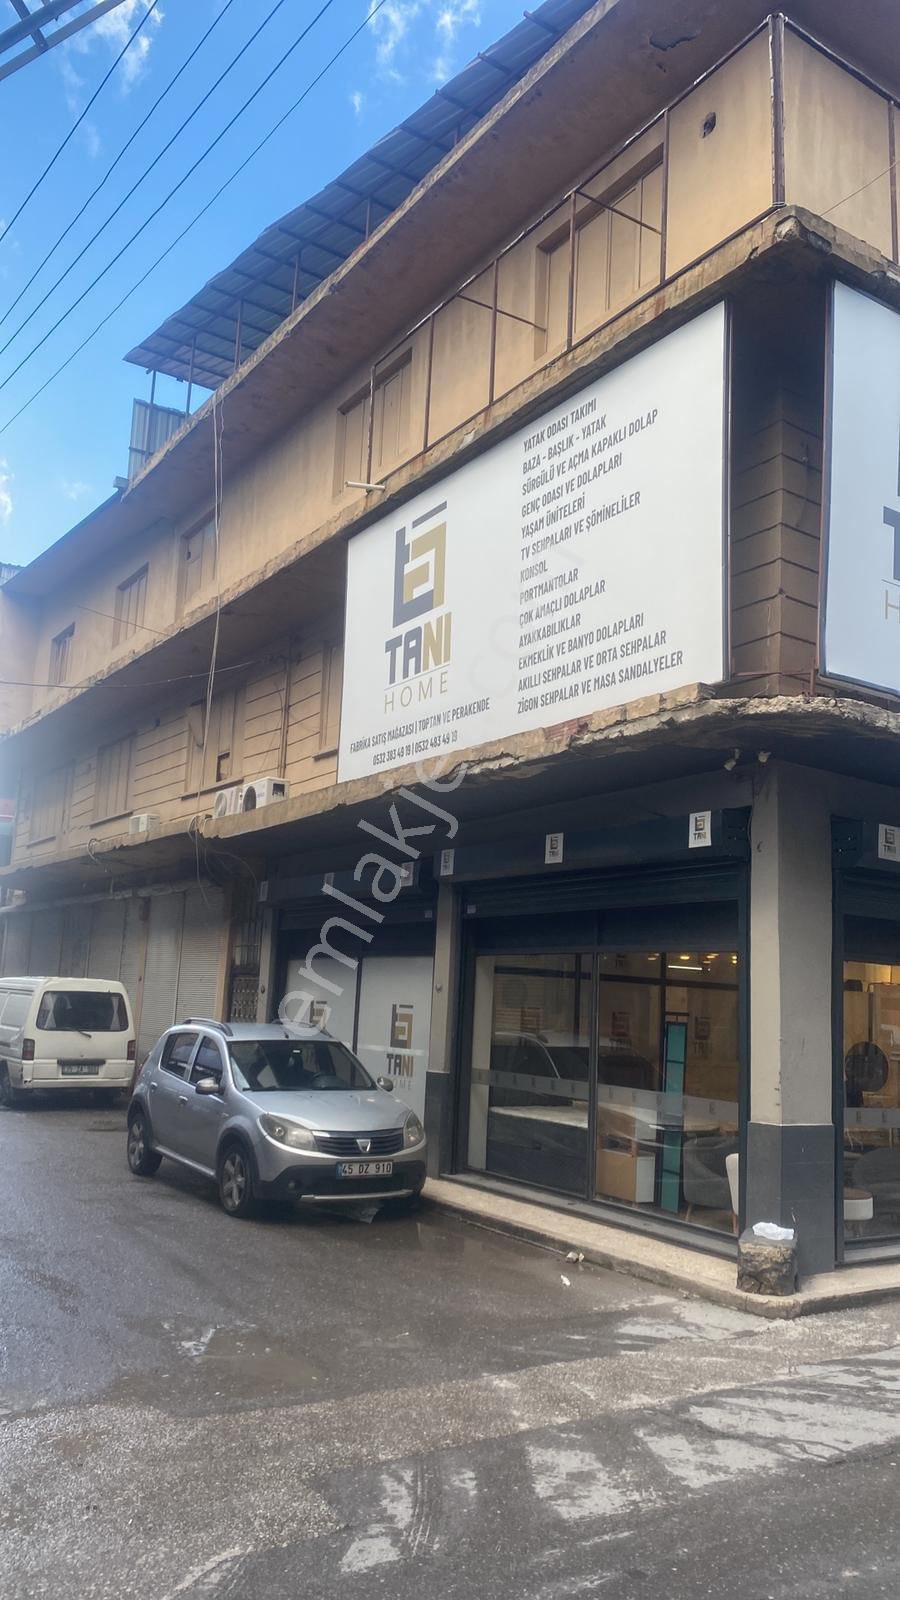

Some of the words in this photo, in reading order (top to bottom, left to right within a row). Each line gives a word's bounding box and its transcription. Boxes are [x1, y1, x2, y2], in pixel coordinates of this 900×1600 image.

[522, 454, 541, 475] BAZA
[548, 434, 574, 460] BAŞLIK
[581, 414, 606, 440] YATAK
[522, 464, 554, 496] SÜRGÜLÜ
[557, 460, 567, 477] VE
[568, 448, 589, 471] AÇMA
[592, 426, 626, 458] KAPAKLI
[629, 408, 658, 437] DOLAP
[524, 429, 545, 453] YATAK
[547, 416, 568, 439] ODASI
[570, 398, 597, 424] TAKIMI
[522, 497, 540, 518] GENÇ
[542, 484, 563, 507] ODASI
[565, 478, 575, 494] VE
[577, 452, 622, 489] DOLAPLARI
[521, 545, 531, 560] TV
[532, 525, 572, 556] SEHPALARI
[574, 519, 585, 535] VE
[586, 491, 640, 533] ŞÖMİNELİLER
[522, 516, 544, 539] YAŞAM
[546, 491, 585, 527] ÜNİTELERİ
[520, 560, 548, 583] KONSOL
[520, 567, 579, 605] PORTMANTOLAR
[519, 609, 534, 629] ÇOK
[564, 579, 606, 608] DOLAPLAR
[519, 612, 581, 648] AYAKKABILIKLAR
[385, 611, 452, 686] TANI
[518, 642, 554, 670] EKMEKLİK
[556, 637, 570, 657] VE
[568, 631, 594, 653] BANYO
[596, 612, 644, 643] DOLAPLARI
[518, 672, 541, 693] AKILLI
[542, 658, 582, 685] SEHPALAR
[583, 654, 594, 671] VE
[595, 646, 618, 666] ORTA
[619, 629, 667, 658] SEHPALAR
[384, 670, 449, 714] HOME
[517, 696, 539, 714] ZİGON
[540, 683, 579, 708] SEHPALAR
[581, 679, 592, 696] VE
[594, 671, 616, 692] MASA
[618, 649, 683, 684] SANDALYELER
[350, 736, 371, 754] FABRİKA
[387, 721, 414, 742] MAĞAZASI
[419, 713, 441, 732] TOPTAN
[442, 710, 451, 724] VE
[451, 697, 490, 720] PERAKENDE
[372, 752, 386, 766] 0532
[386, 1053, 414, 1077] TANI
[342, 1163, 353, 1175] 45
[358, 1163, 370, 1174] DZ
[375, 1162, 391, 1173] 910
